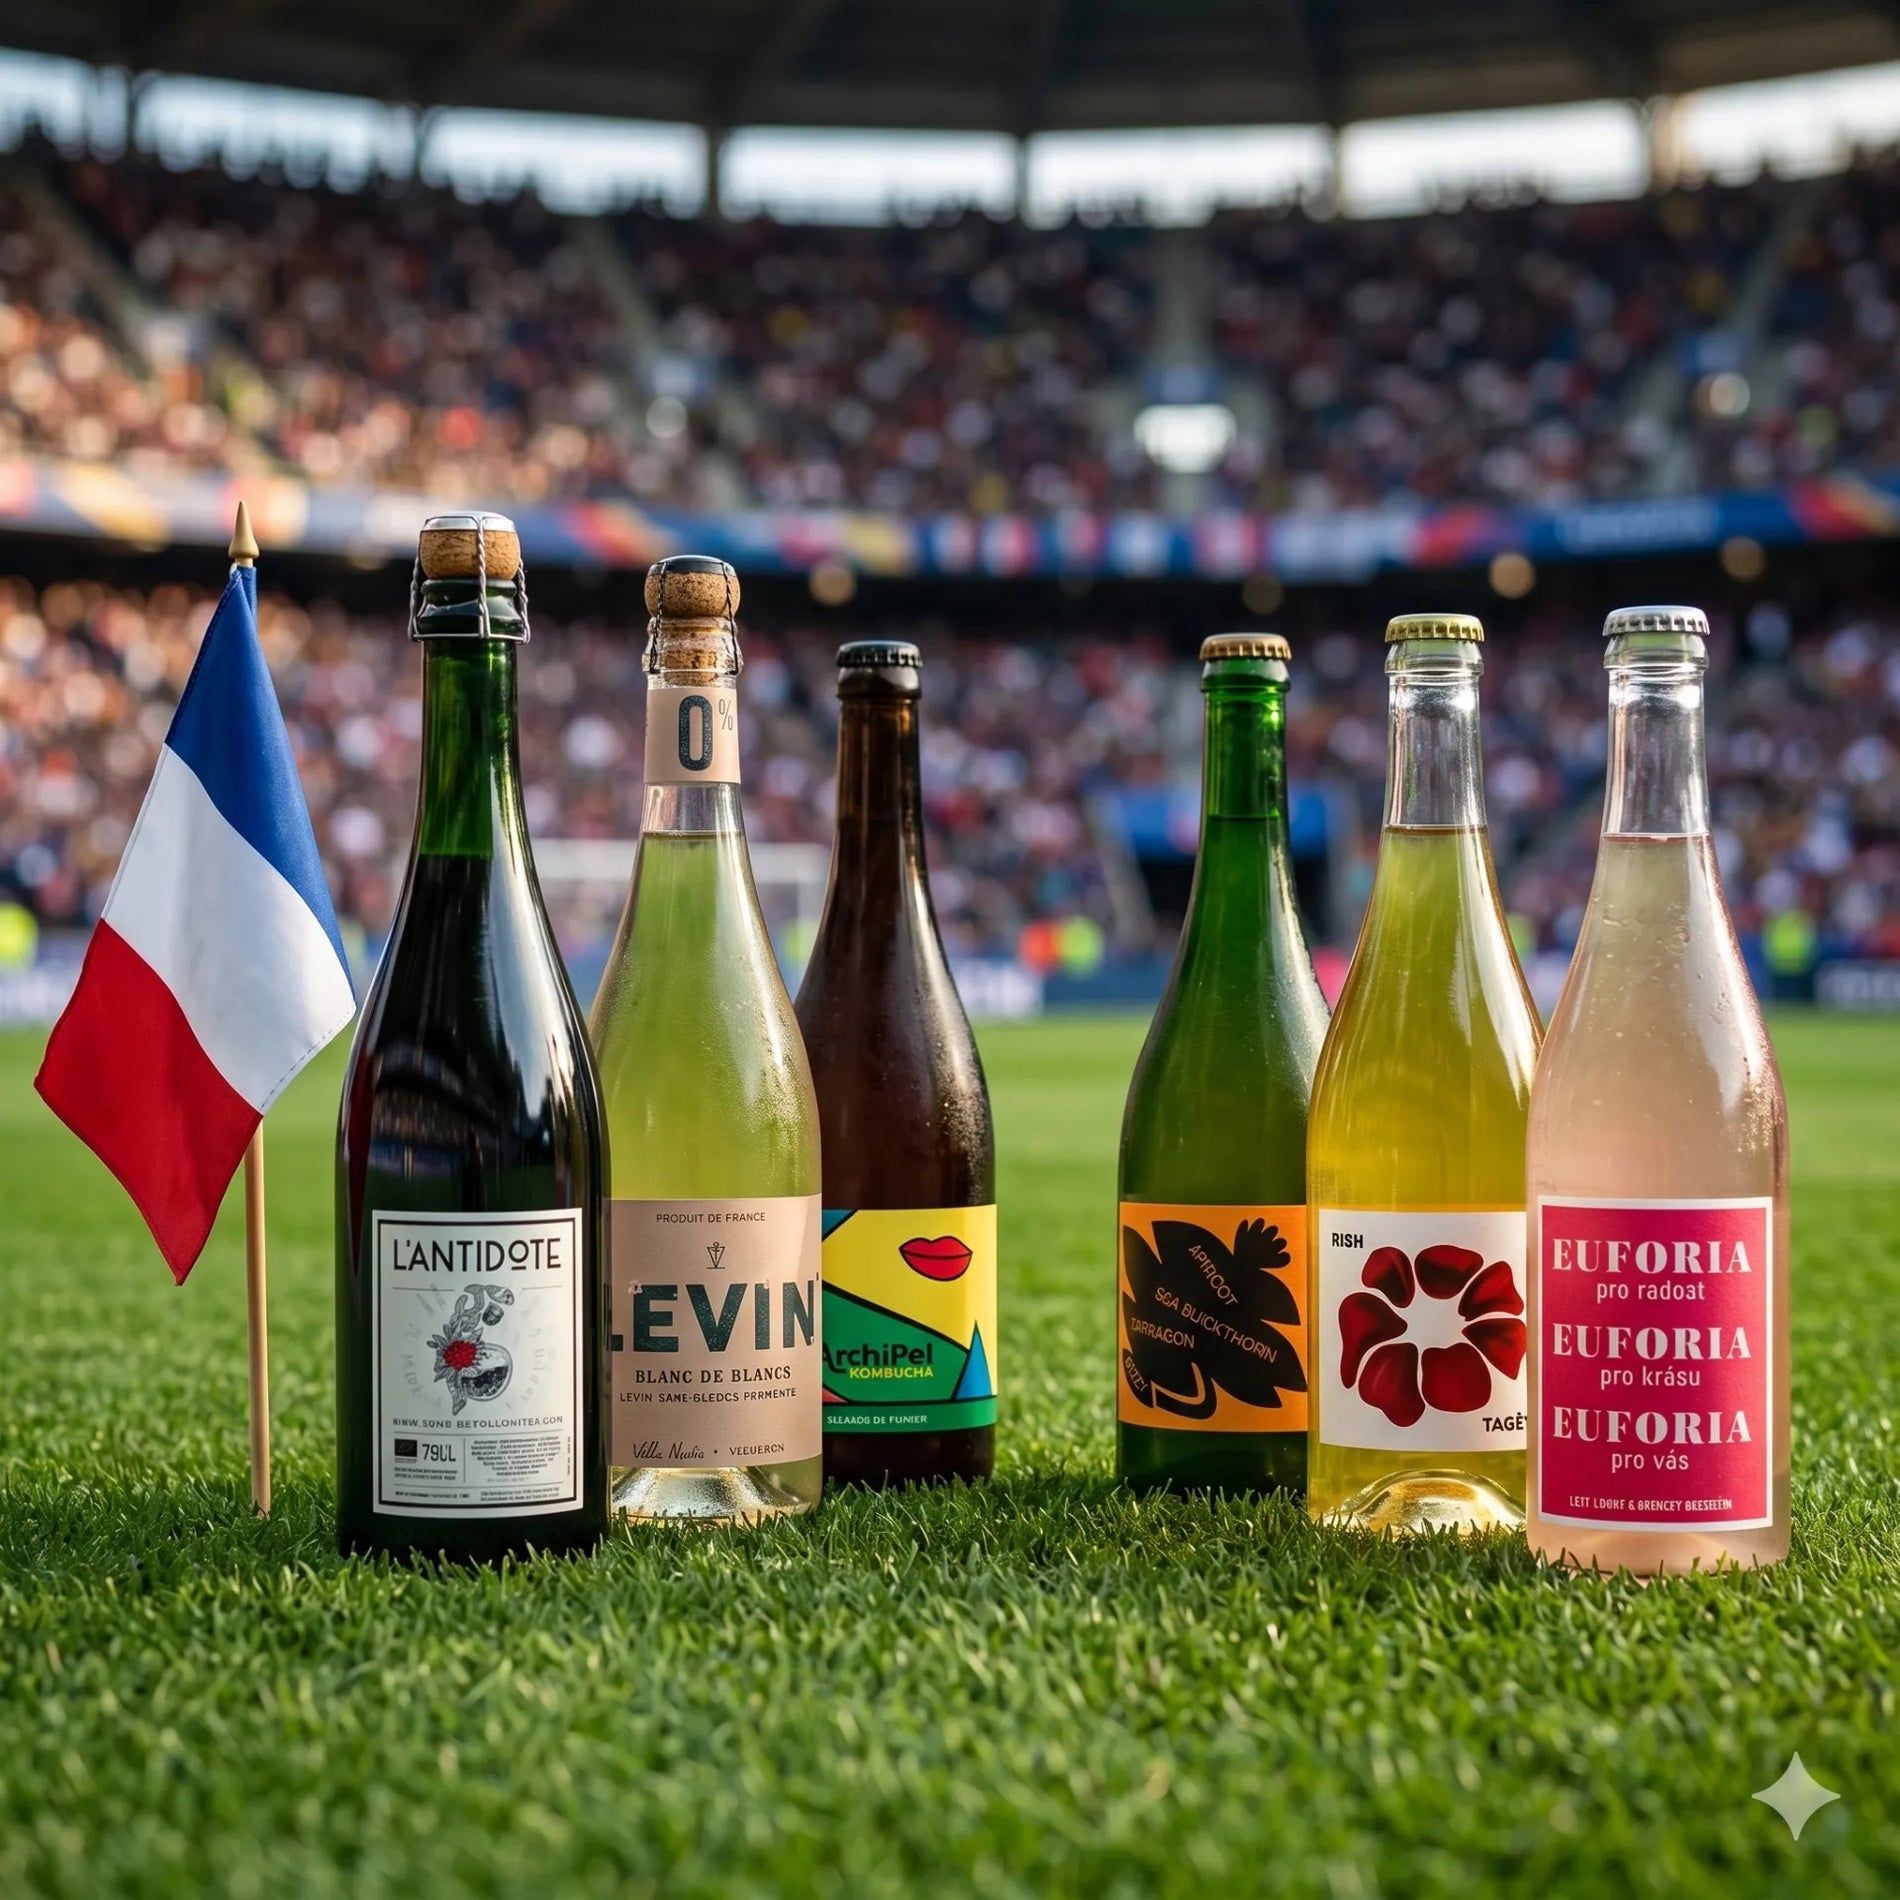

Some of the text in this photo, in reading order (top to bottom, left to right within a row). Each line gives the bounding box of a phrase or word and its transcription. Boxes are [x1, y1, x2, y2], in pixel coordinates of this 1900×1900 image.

[656, 1212, 766, 1223] PRODUIT DE FRANCE
[1331, 1232, 1364, 1249] RISH
[393, 1237, 561, 1272] L'ANTIDOTE
[1552, 1238, 1752, 1275] EUFORIA
[1596, 1283, 1630, 1304] pro
[1552, 1322, 1752, 1360] EUFORIA
[635, 1365, 792, 1384] BLANC DE BLANCS
[849, 1366, 934, 1379] KOMBUCHA
[1600, 1365, 1701, 1390] pro krásu
[620, 1392, 653, 1402] LEVIN
[873, 1415, 886, 1425] DE
[1552, 1405, 1752, 1445] EUFORIA
[1611, 1448, 1690, 1473] pro vás
